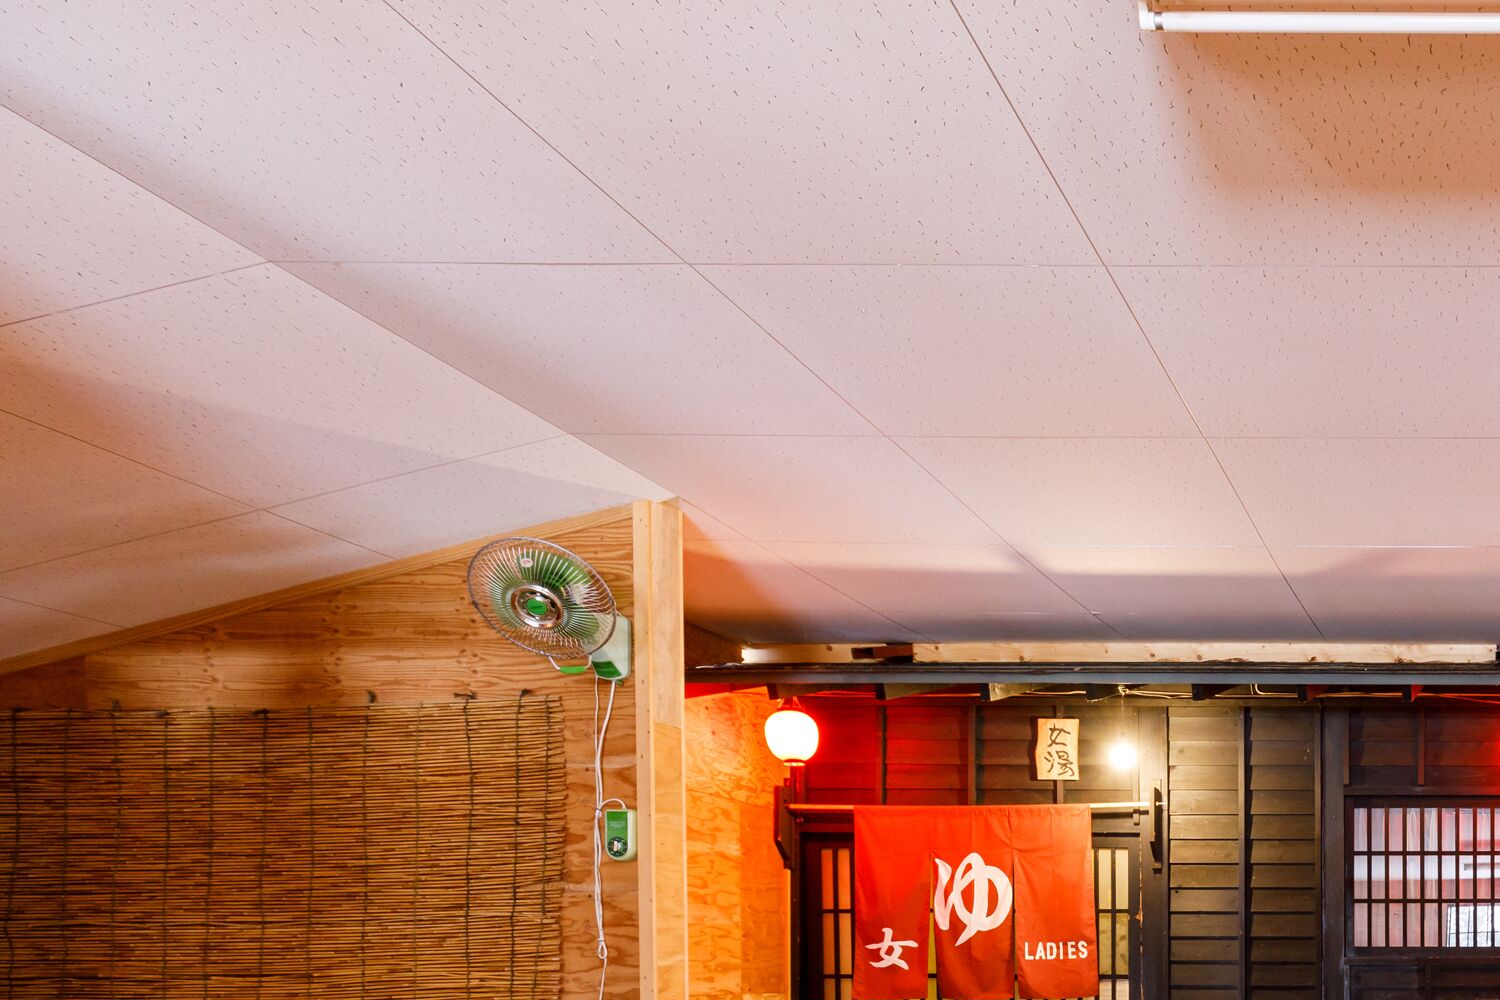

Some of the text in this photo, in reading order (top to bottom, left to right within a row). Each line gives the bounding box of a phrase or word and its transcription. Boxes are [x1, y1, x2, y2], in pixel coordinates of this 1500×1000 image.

[1044, 722, 1075, 777] 女湯
[933, 852, 1013, 947] ゆ
[865, 927, 919, 970] 女
[1024, 940, 1089, 961] LADIES
